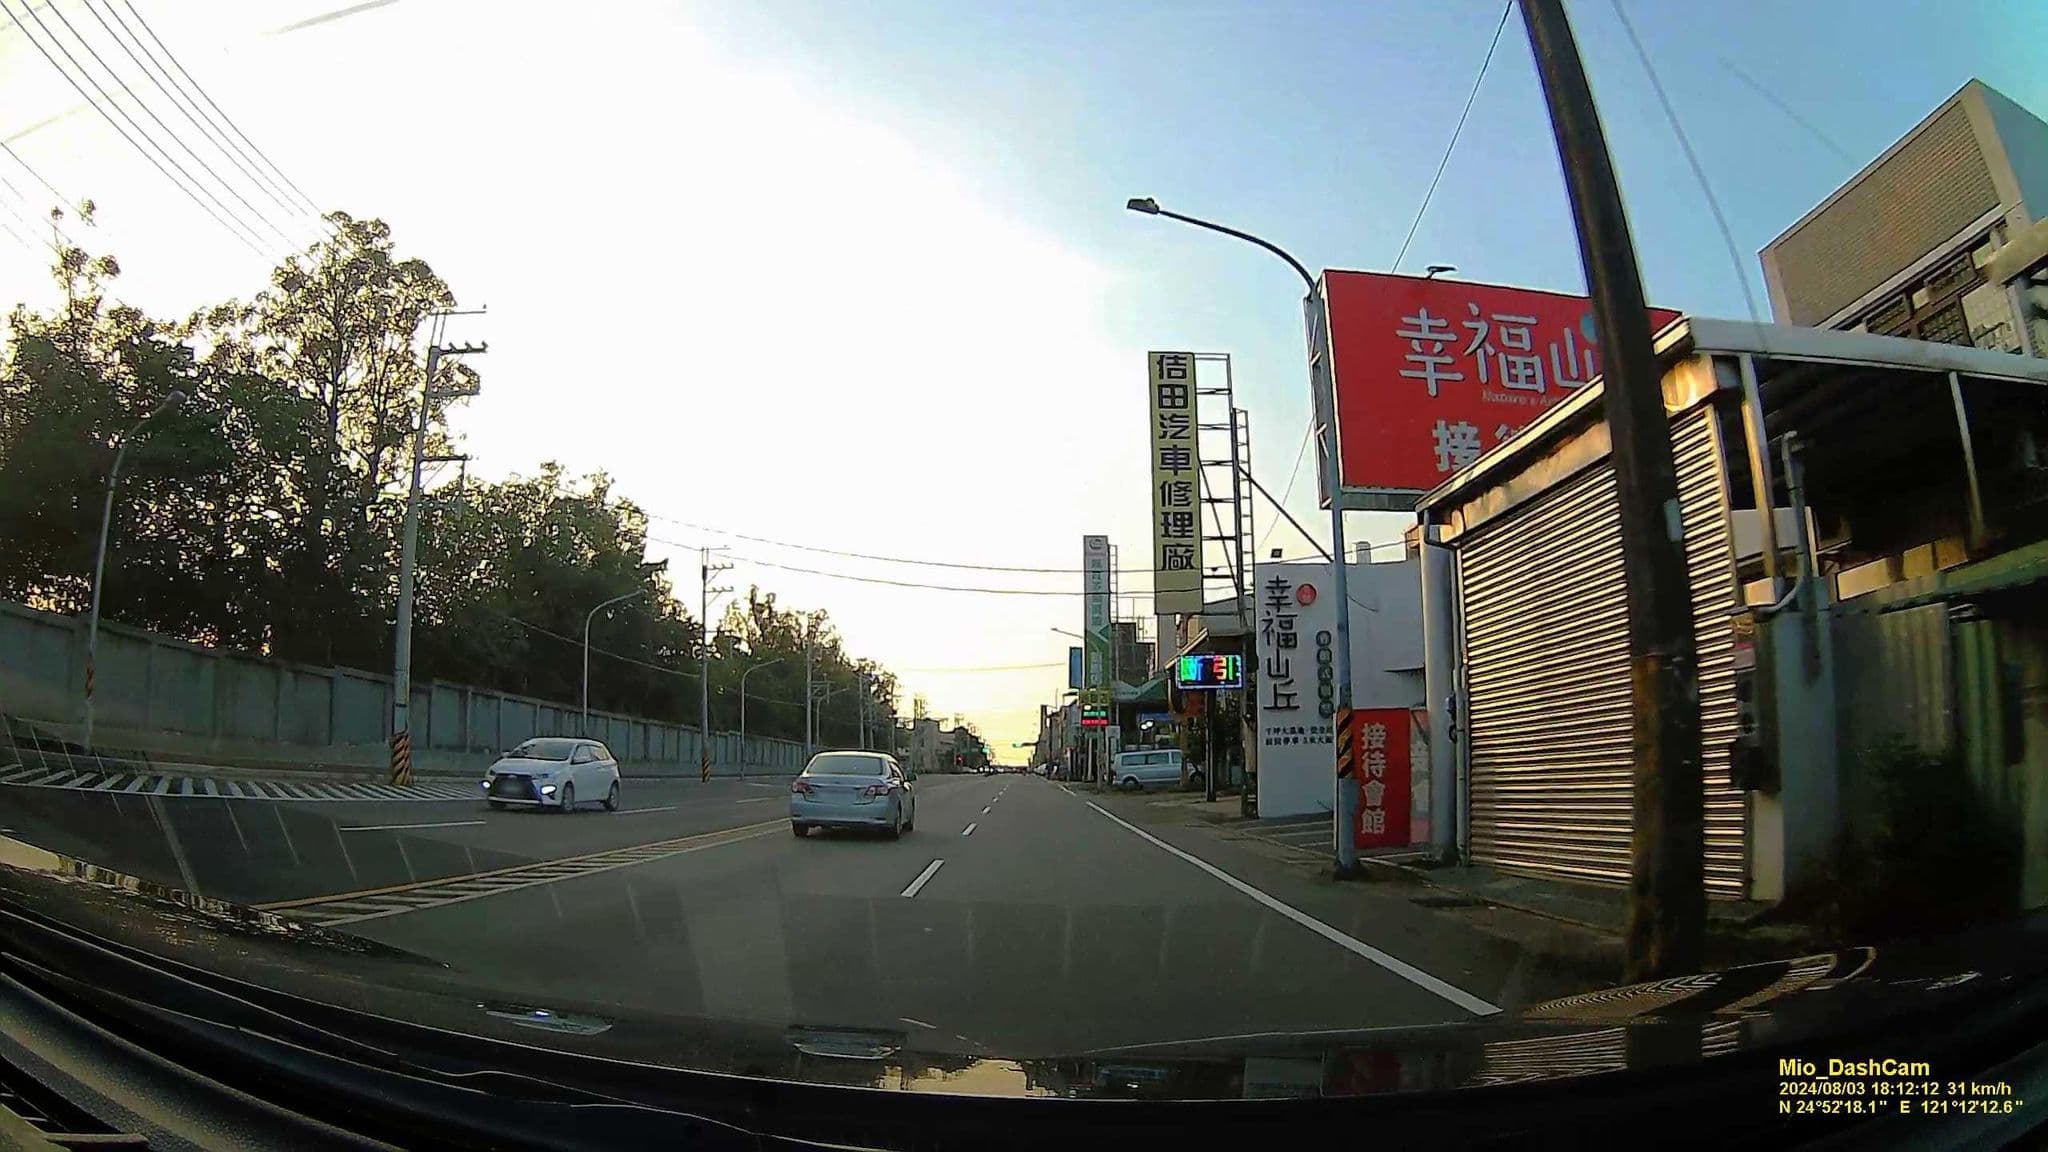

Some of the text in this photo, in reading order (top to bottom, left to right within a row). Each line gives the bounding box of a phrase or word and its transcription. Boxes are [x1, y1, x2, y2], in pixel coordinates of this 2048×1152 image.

[1157, 354, 1197, 571] 佶田汽車修理廠
[1261, 575, 1300, 711] 幸福山丘
[1361, 723, 1389, 835] 接待會館
